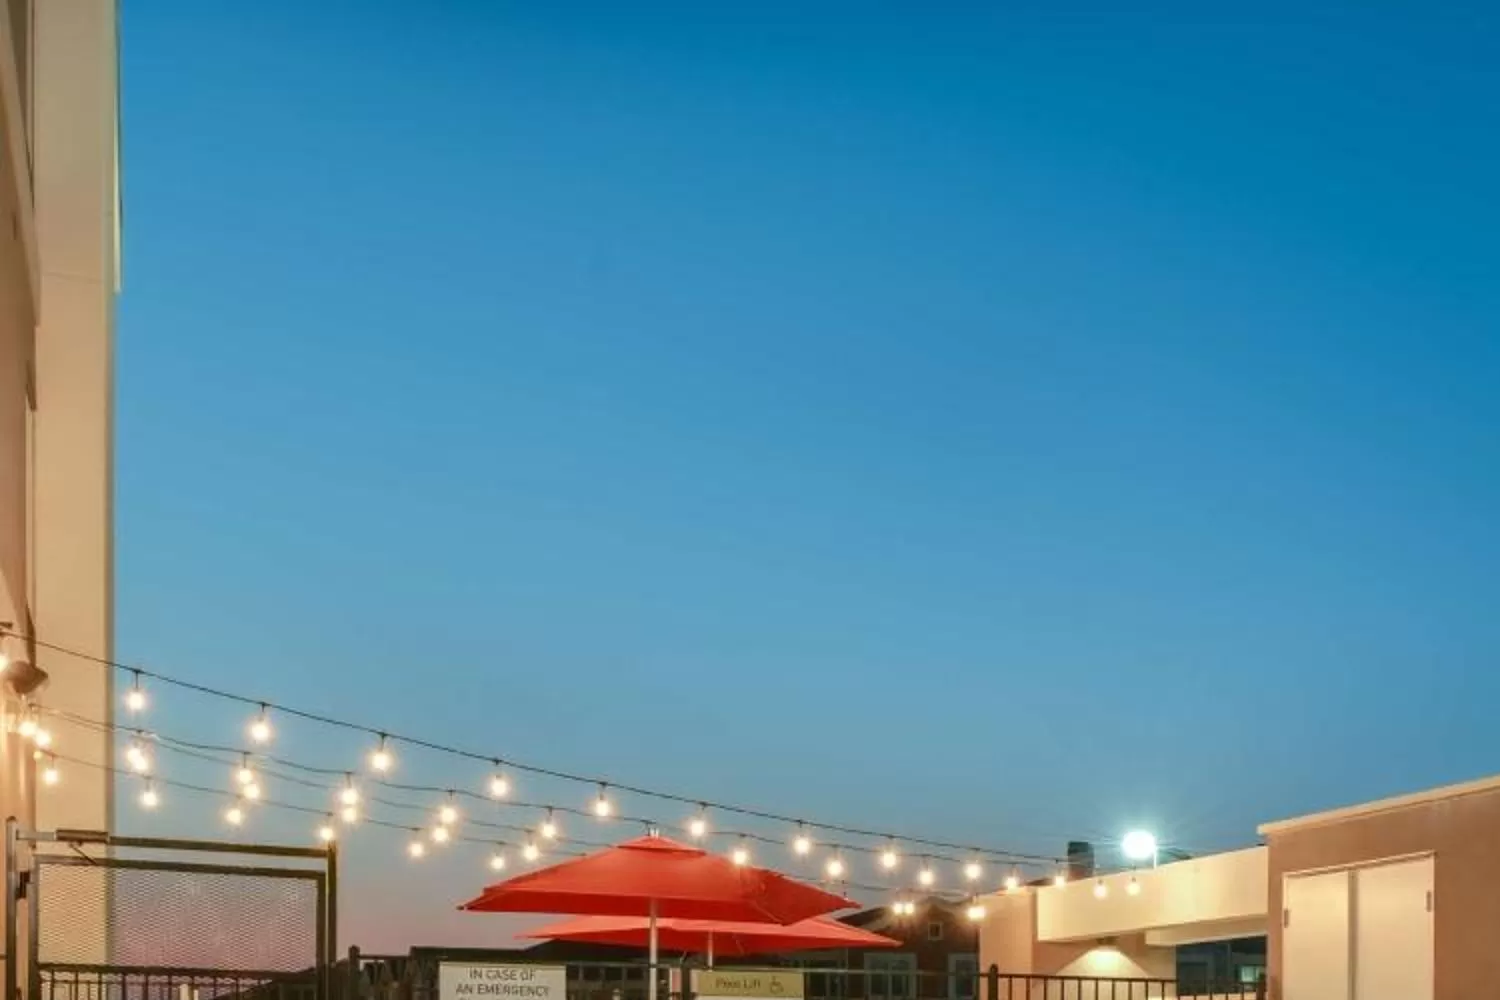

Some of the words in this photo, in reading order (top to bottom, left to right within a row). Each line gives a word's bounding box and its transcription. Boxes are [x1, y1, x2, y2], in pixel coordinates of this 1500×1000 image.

[469, 968, 483, 980] IN
[486, 969, 517, 981] CASE
[520, 969, 536, 981] OF
[456, 983, 473, 995] AN
[477, 983, 550, 997] EMERGENCY
